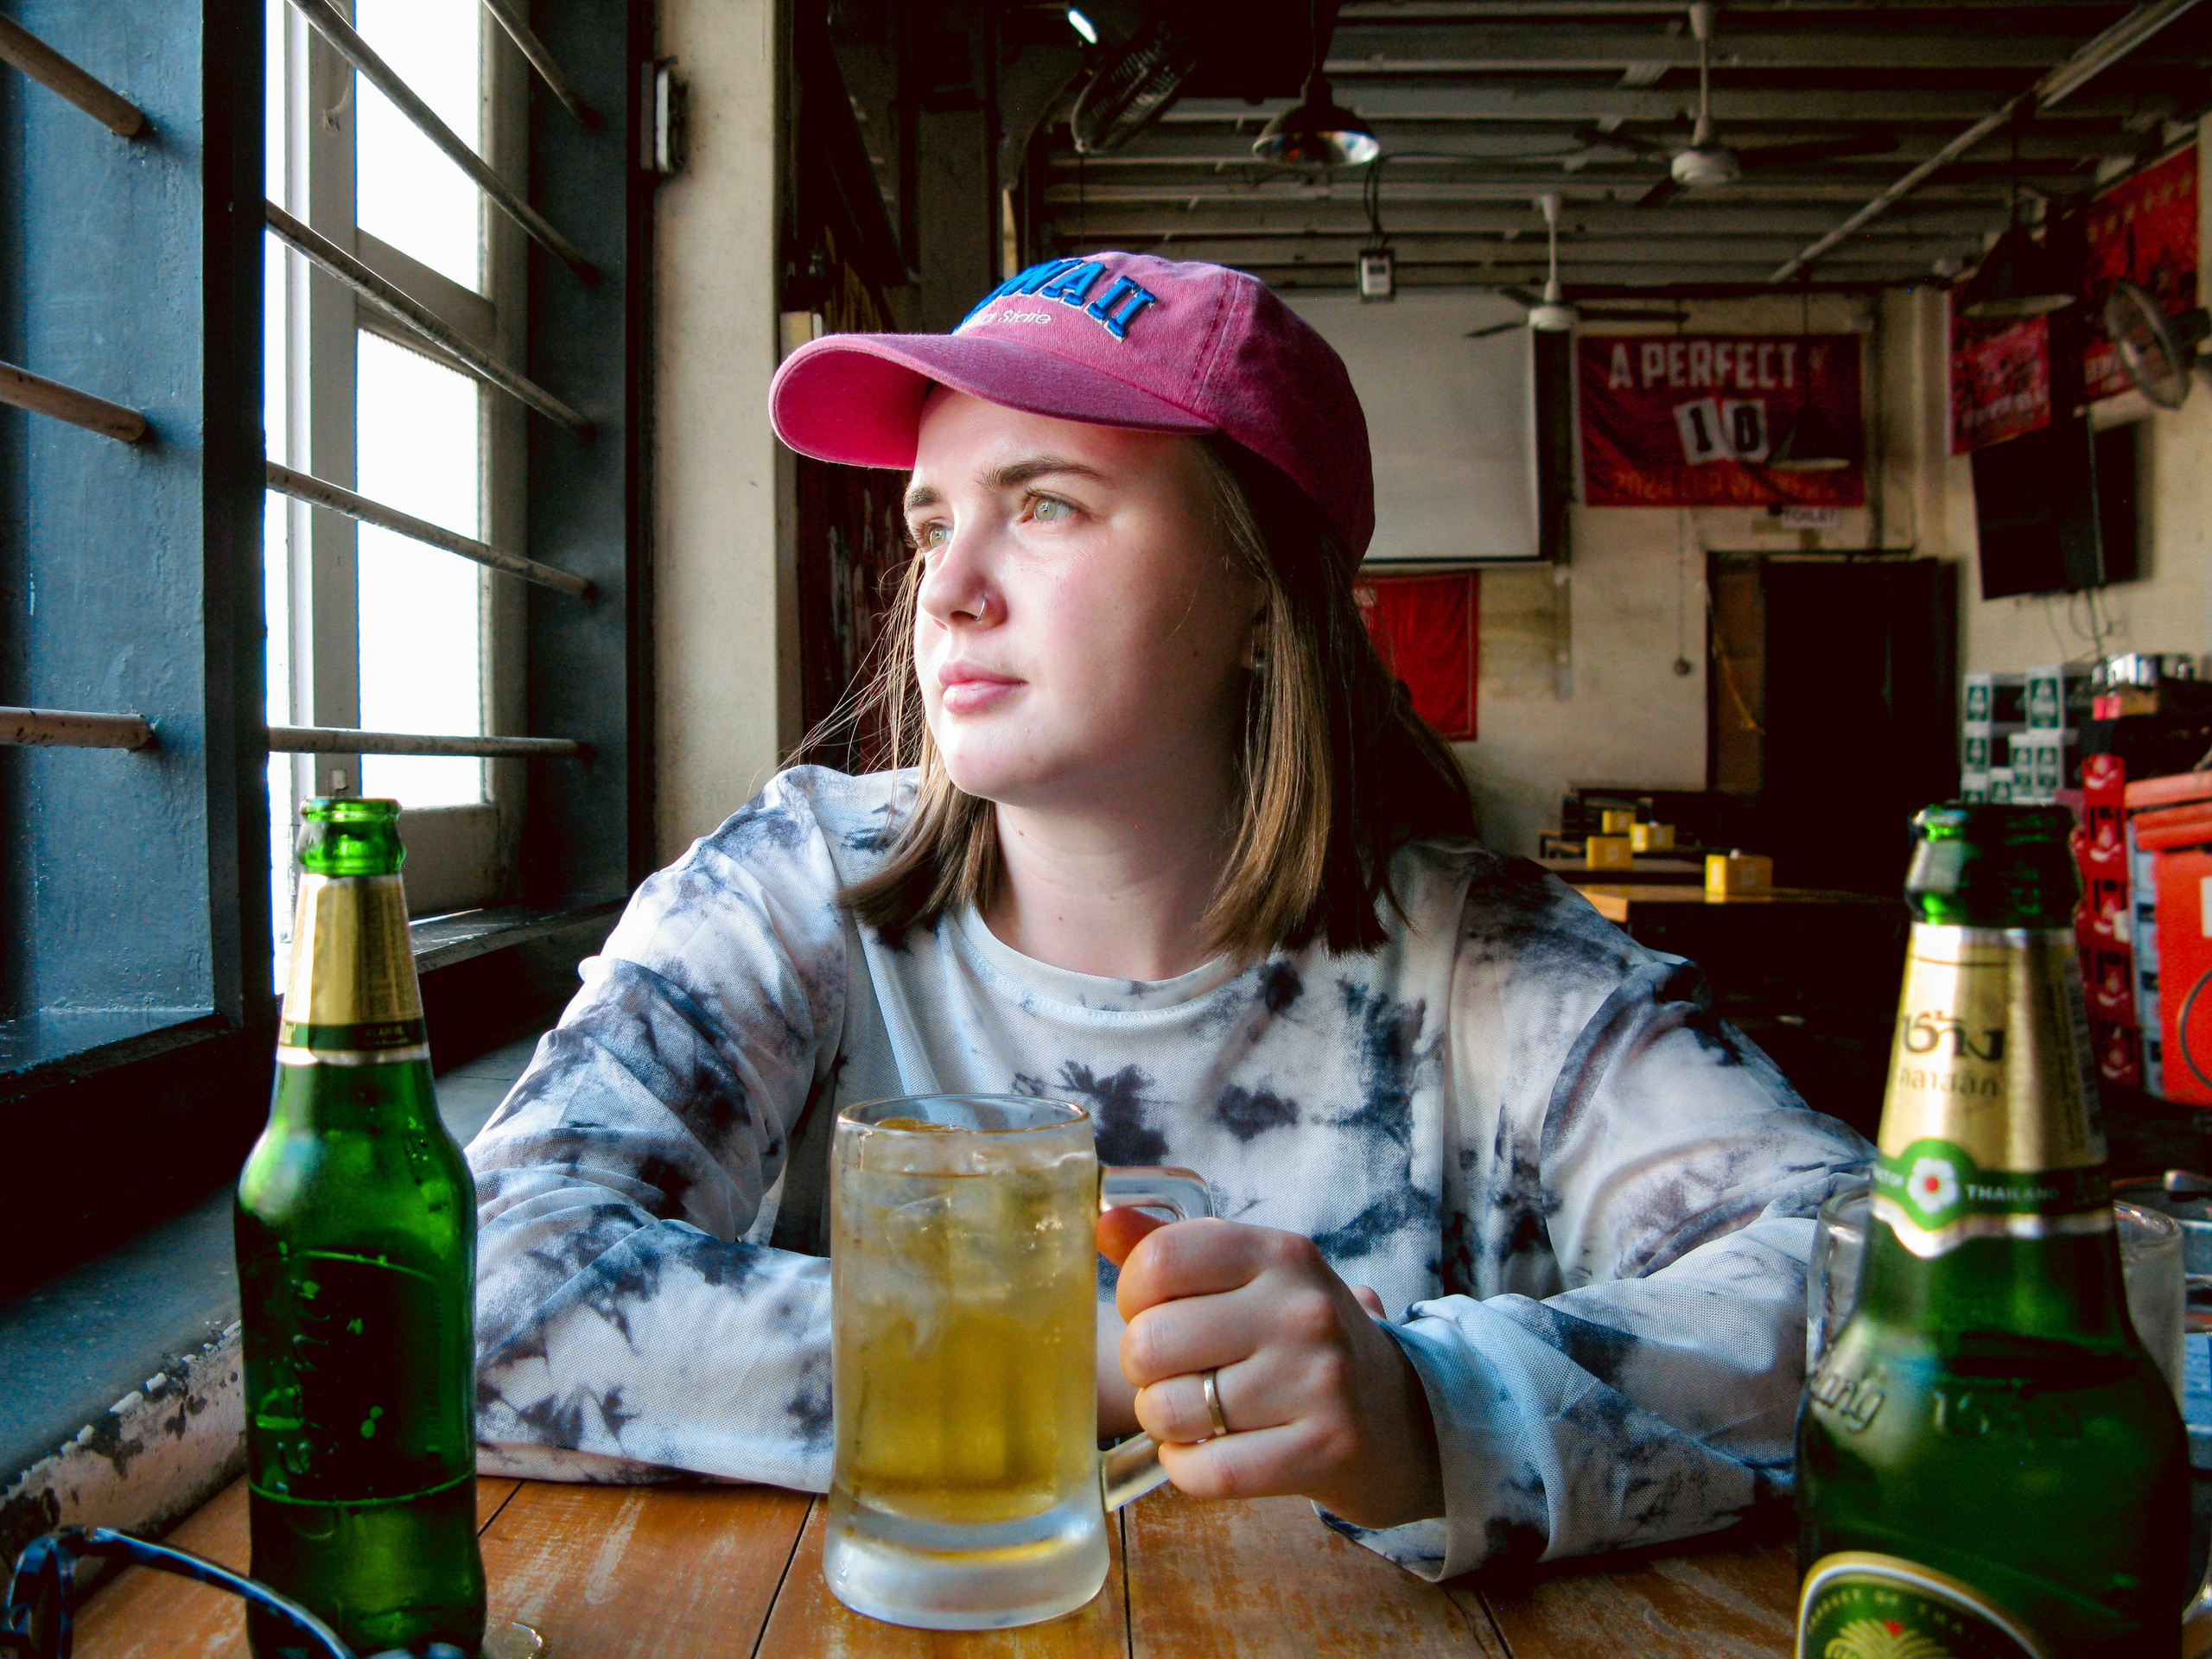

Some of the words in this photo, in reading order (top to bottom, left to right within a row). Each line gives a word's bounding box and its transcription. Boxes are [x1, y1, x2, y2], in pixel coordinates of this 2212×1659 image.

[997, 309, 1052, 325] State
[1608, 342, 1634, 390] A
[1640, 340, 1798, 391] PERFECT
[1685, 402, 1764, 457] 10
[1966, 1183, 2062, 1202] THAILAND
